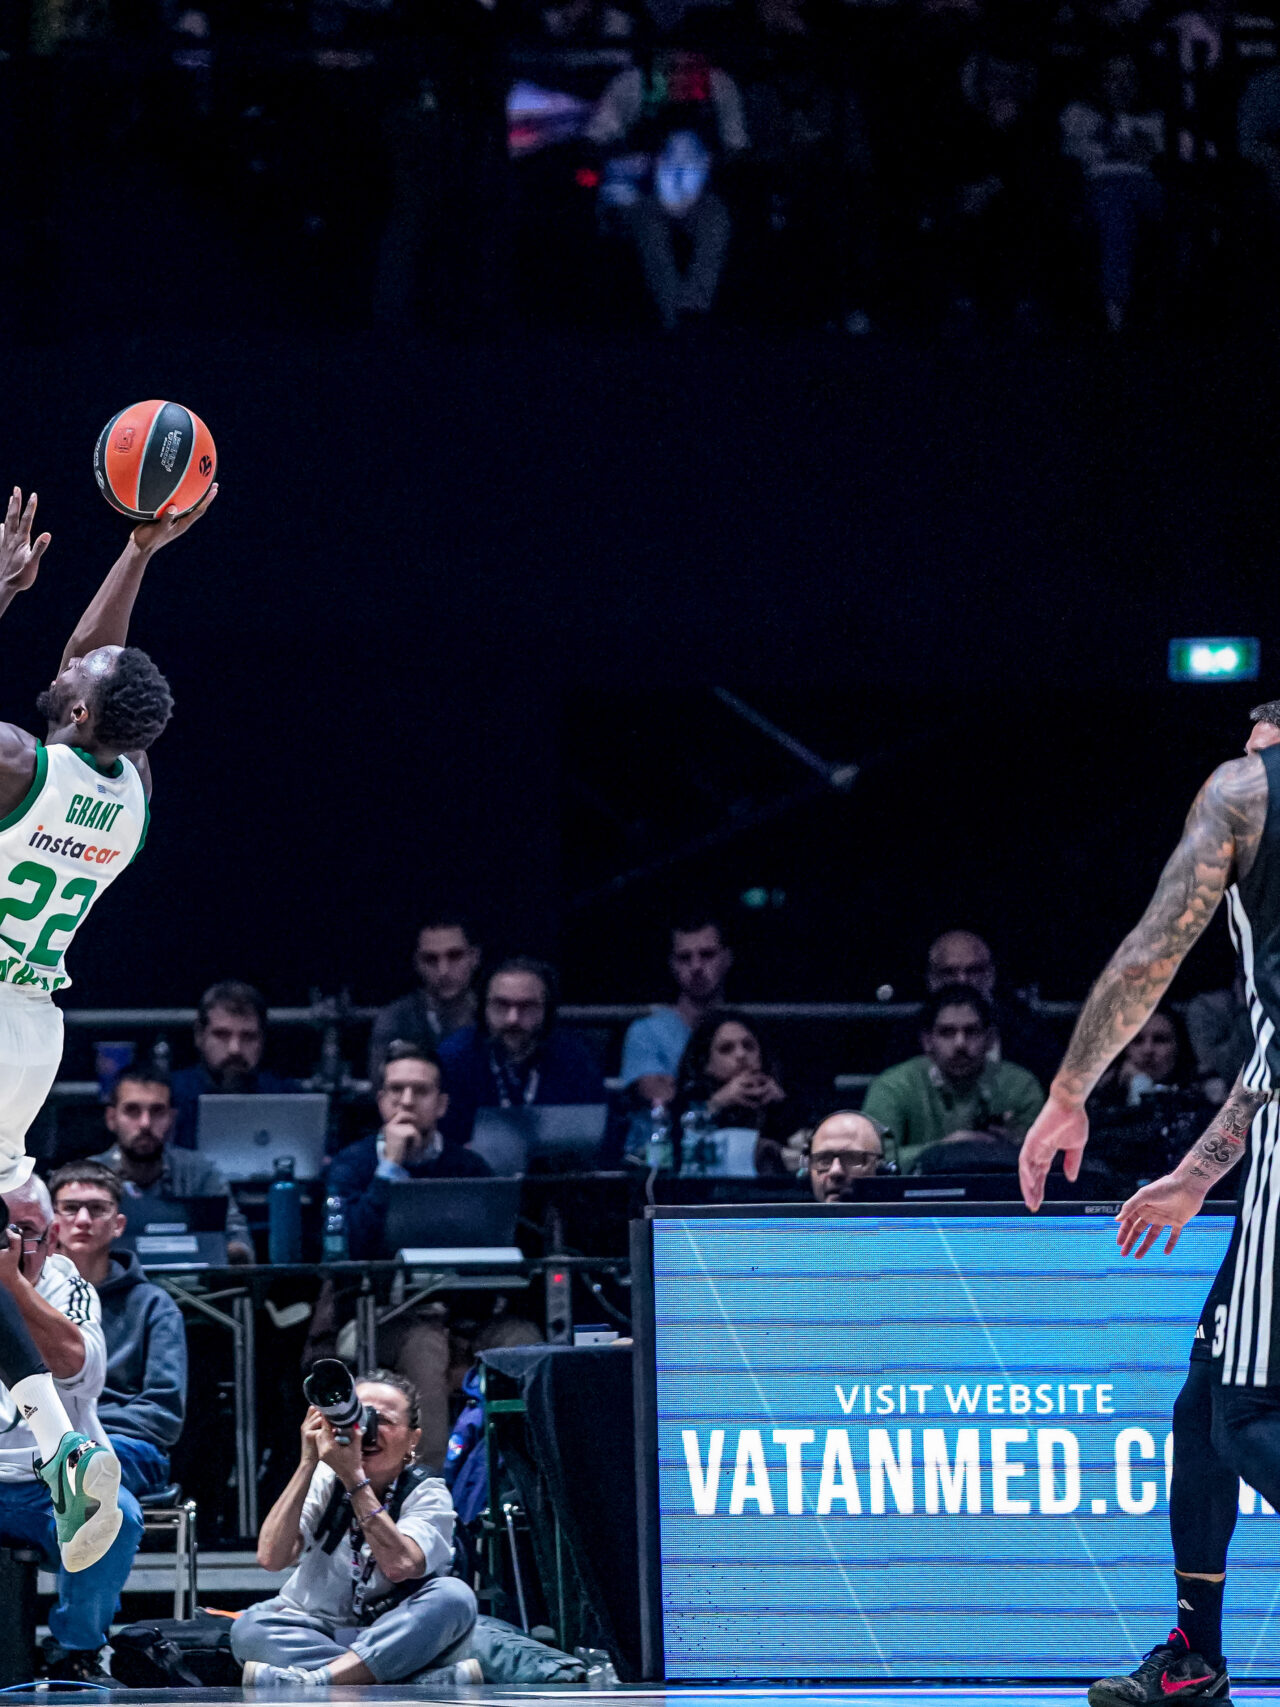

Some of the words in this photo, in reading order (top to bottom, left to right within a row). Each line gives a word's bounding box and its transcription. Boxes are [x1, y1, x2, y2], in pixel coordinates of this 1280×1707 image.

[65, 794, 124, 832] GRANT
[28, 825, 120, 866] instacar
[835, 1384, 933, 1415] VISIT
[944, 1383, 1114, 1415] WEBSITE
[681, 1428, 1276, 1516] VATANMED.C
